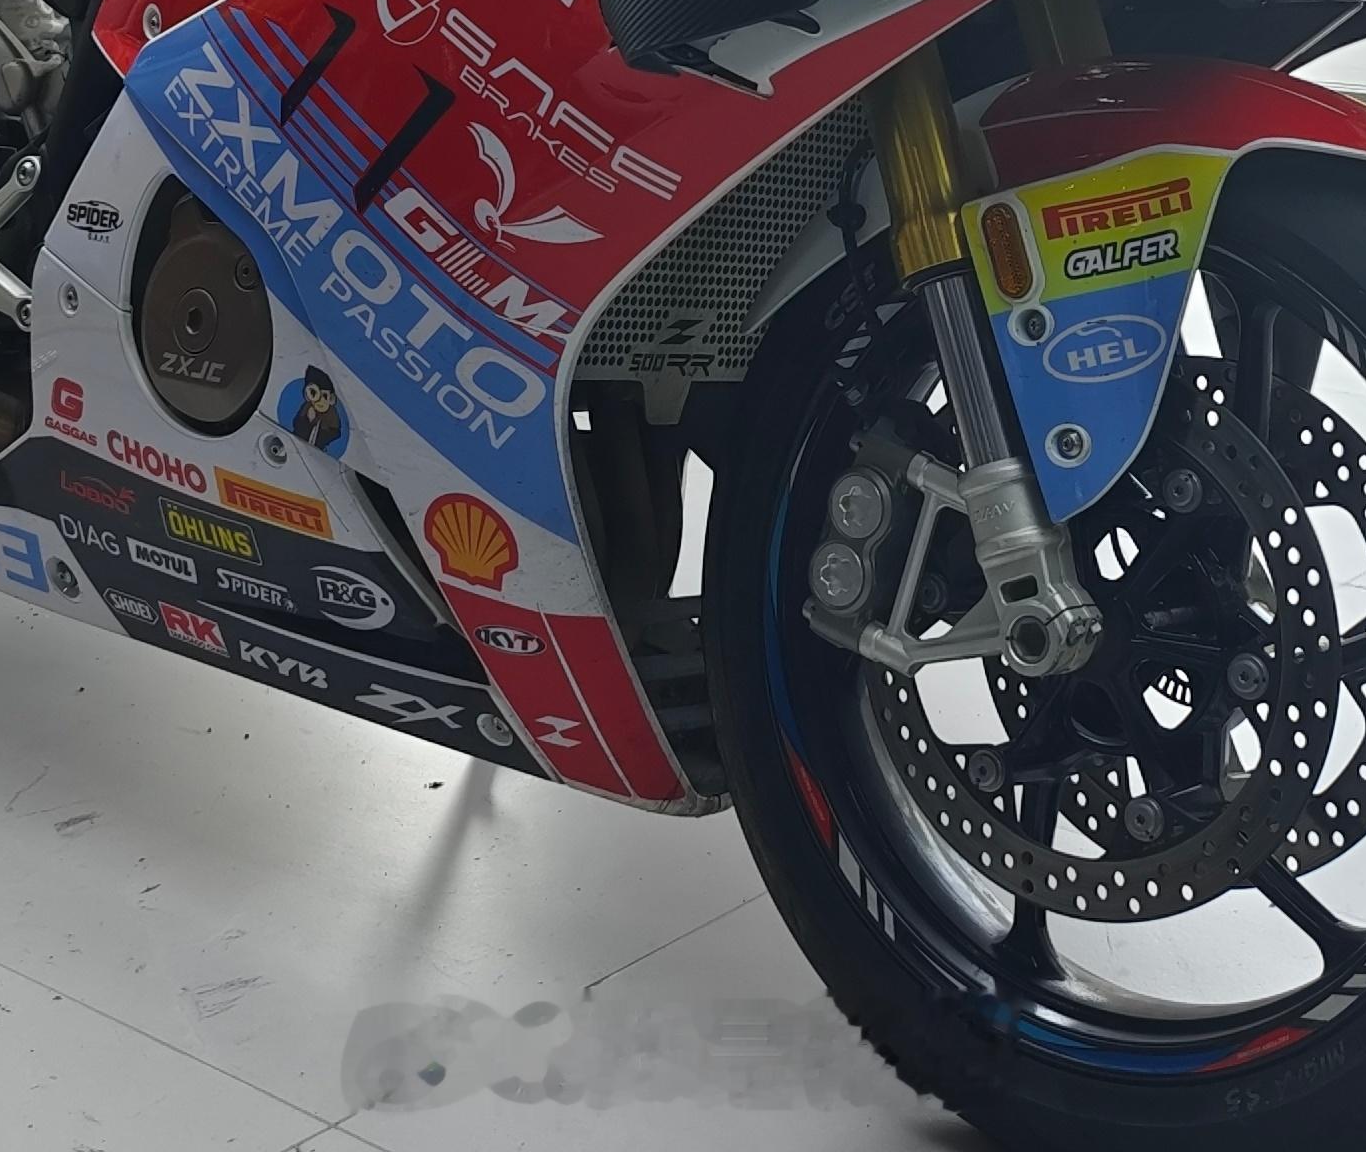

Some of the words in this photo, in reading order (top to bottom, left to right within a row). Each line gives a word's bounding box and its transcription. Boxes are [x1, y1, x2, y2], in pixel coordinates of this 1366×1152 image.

[459, 65, 618, 194] BRAKES
[163, 76, 315, 268] EXTREME
[66, 203, 120, 230] SPIDER
[1041, 177, 1193, 240] PIRELLI
[179, 41, 547, 420] ZXMOTO
[1065, 231, 1179, 279] GALFER
[158, 351, 227, 384] ZXJC
[320, 272, 517, 450] PASSION
[628, 353, 715, 377] 500RR
[1066, 336, 1148, 372] HEL
[44, 417, 98, 447] GASGAS
[106, 430, 208, 493] CHOHO
[221, 477, 325, 534] PIRELLI
[59, 513, 121, 556] DIAG
[167, 505, 254, 558] ÖHLINS
[134, 544, 193, 578] MOTUL
[112, 592, 153, 619] SHOEI
[216, 567, 288, 608] SPIDER
[317, 576, 378, 611] R&G
[161, 607, 223, 647] RK
[481, 627, 539, 653] KYT
[355, 684, 465, 729] ZX
